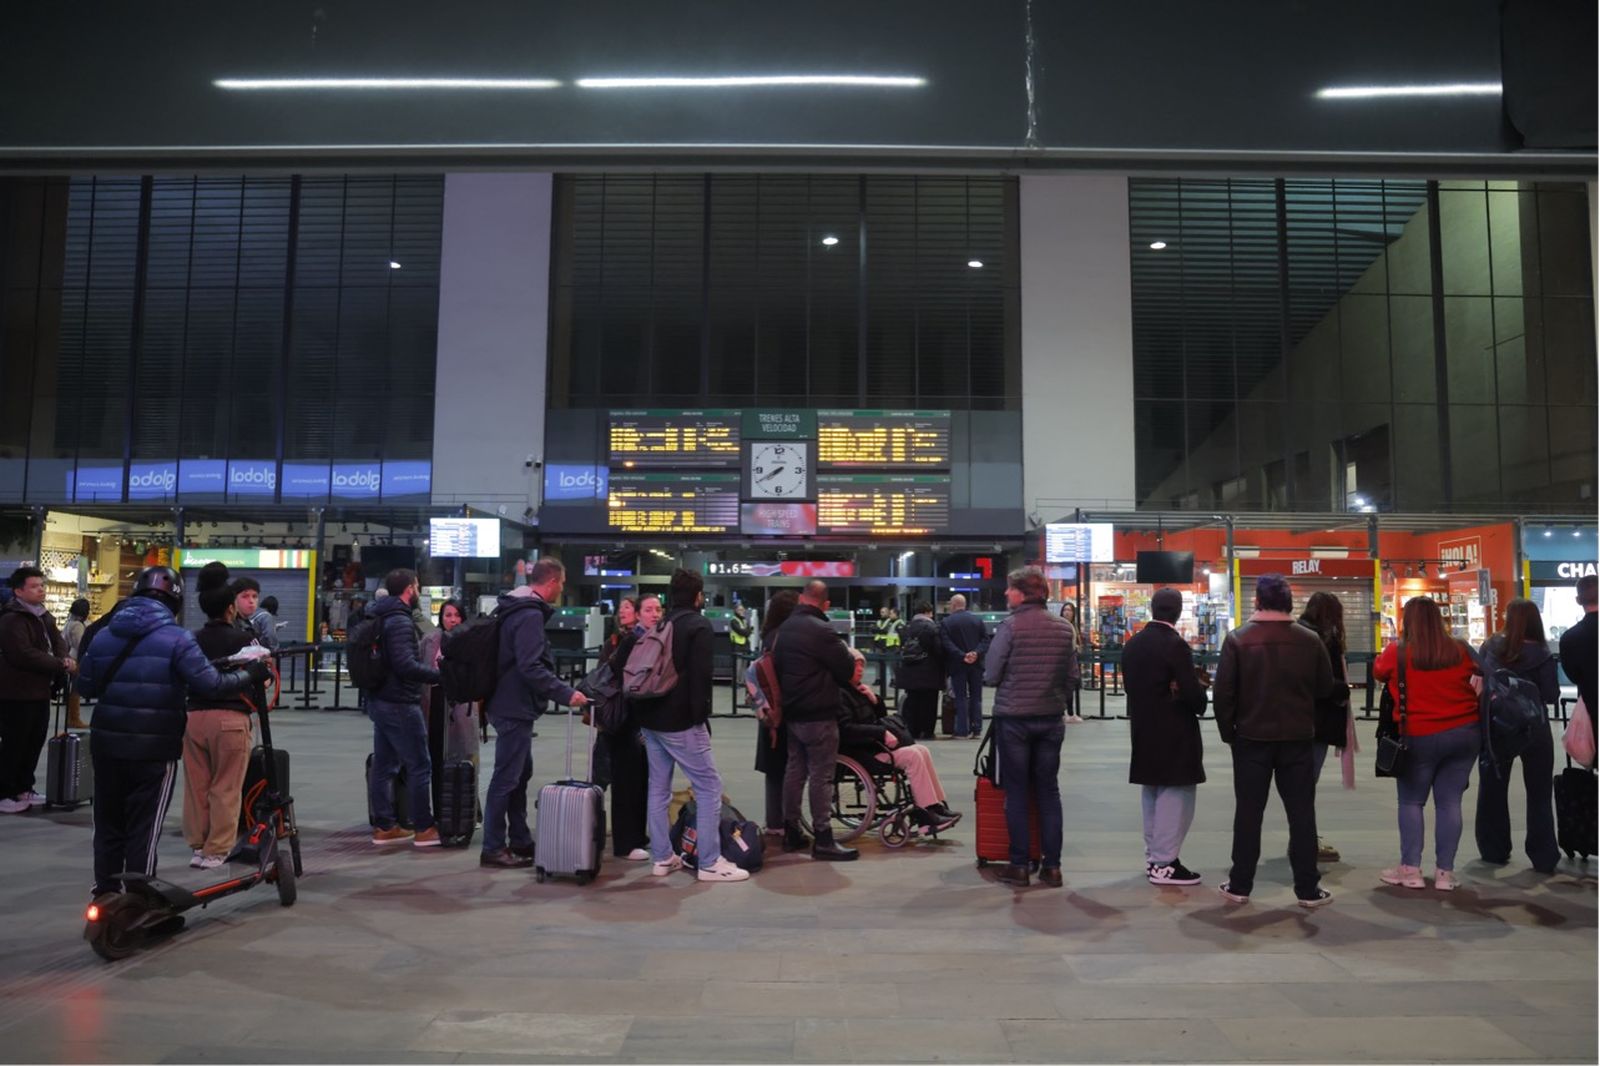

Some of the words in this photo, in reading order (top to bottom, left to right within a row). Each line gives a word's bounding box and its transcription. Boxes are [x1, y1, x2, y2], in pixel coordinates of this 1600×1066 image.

[759, 413, 783, 423] TRENES
[784, 413, 800, 423] ALTA
[761, 423, 798, 432] VELOCIDAD
[755, 466, 763, 474] 9
[794, 466, 802, 474] 3
[775, 485, 782, 494] 6
[1557, 562, 1599, 578] CHA
